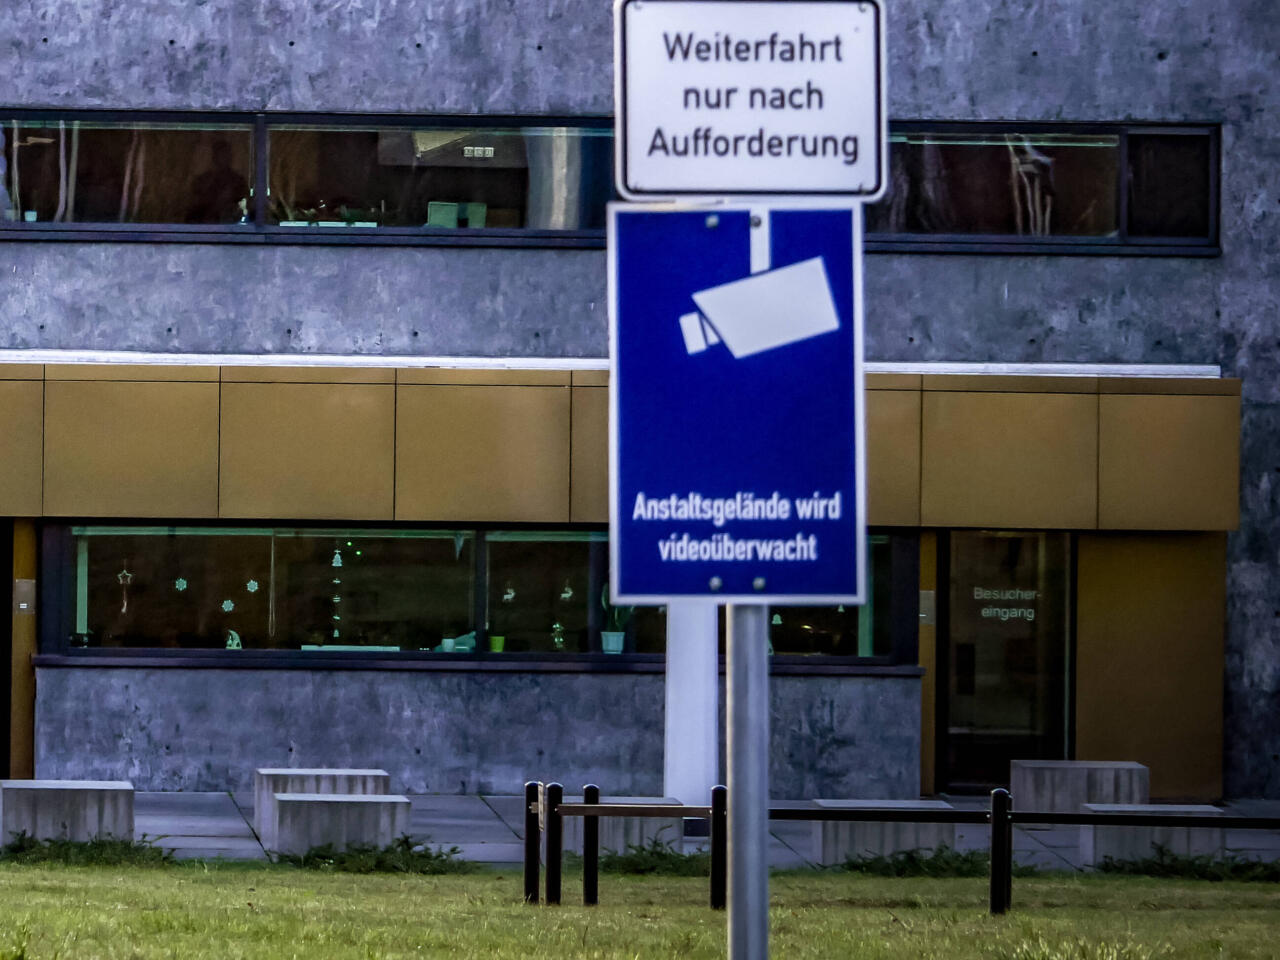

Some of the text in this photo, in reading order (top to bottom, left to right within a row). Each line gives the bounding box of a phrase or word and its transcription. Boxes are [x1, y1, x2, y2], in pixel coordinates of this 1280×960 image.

[662, 31, 843, 63] Weiterfahrt
[683, 80, 824, 110] nur nach
[647, 126, 859, 166] Aufforderung
[632, 491, 842, 527] Anstaltsgelände wird
[658, 532, 818, 562] videoüberwacht
[973, 586, 1042, 601] Besucher-
[980, 605, 1036, 621] eingang
